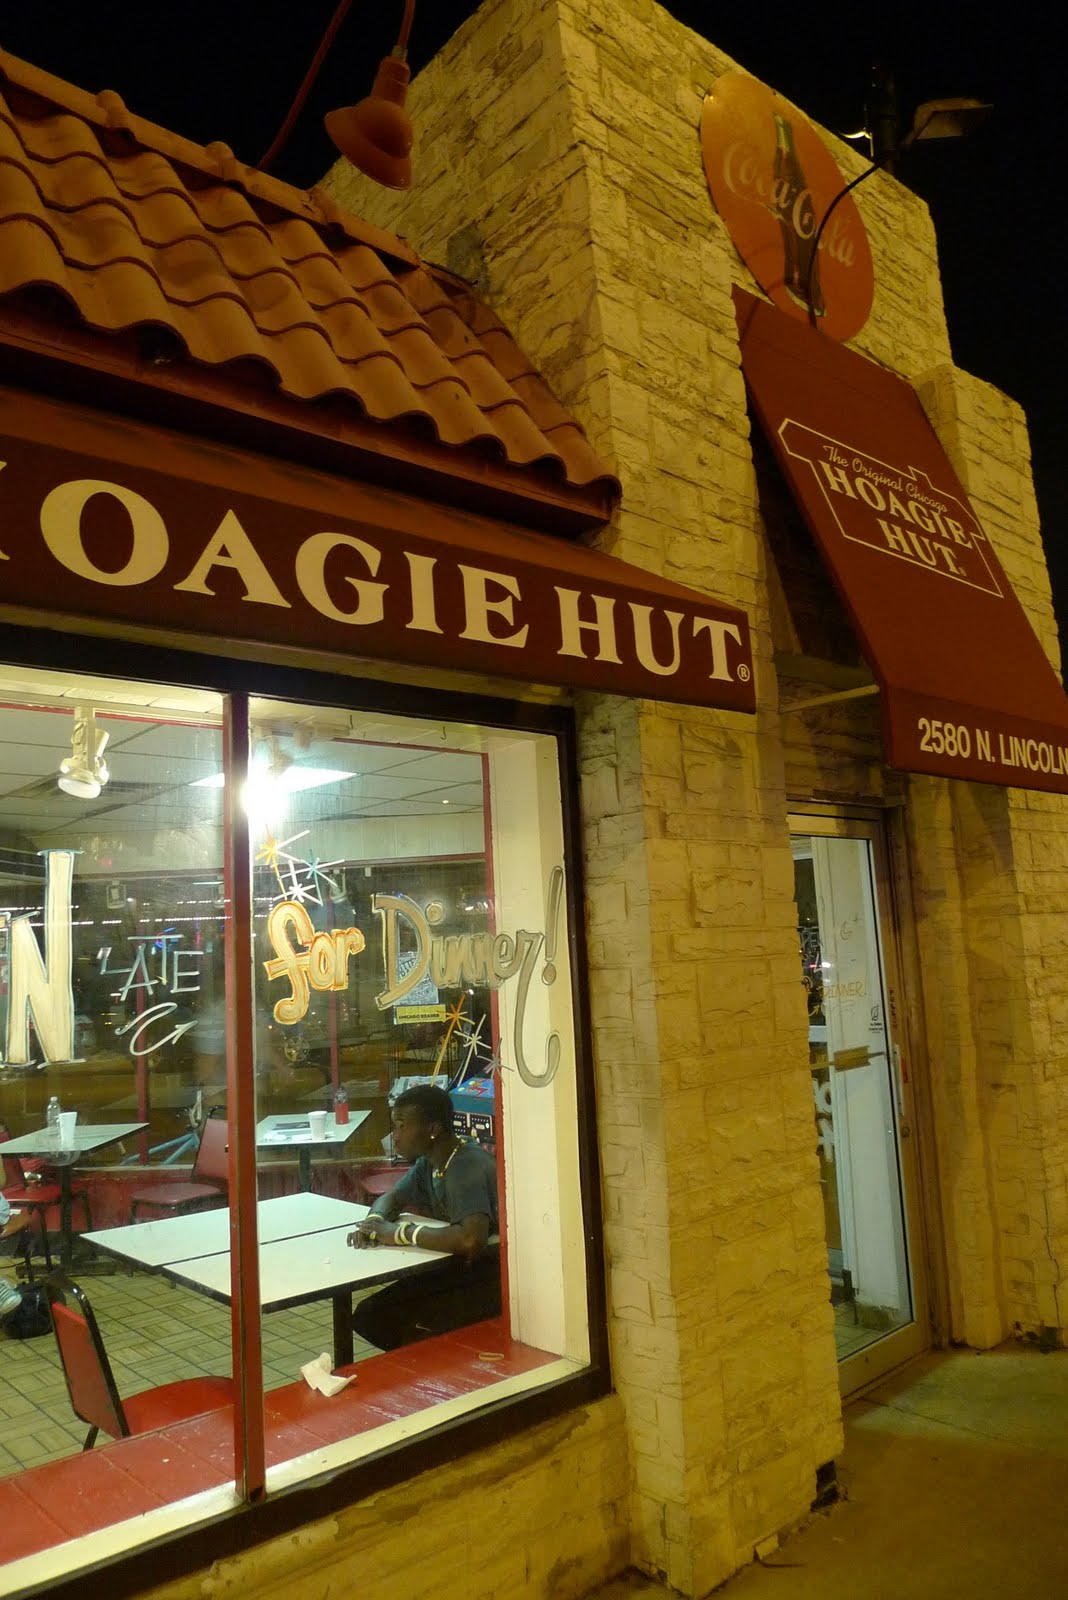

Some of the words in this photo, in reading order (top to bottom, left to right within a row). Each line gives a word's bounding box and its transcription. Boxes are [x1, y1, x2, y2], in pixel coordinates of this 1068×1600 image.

[818, 460, 972, 549] HOAGIE
[823, 445, 848, 468] The
[852, 458, 903, 492] Original
[906, 482, 947, 514] Chicago
[0, 461, 529, 648] OAGIE
[554, 586, 742, 682] HUT
[918, 717, 971, 759] 2580
[975, 728, 996, 763] N.
[97, 934, 204, 1001] LATE
